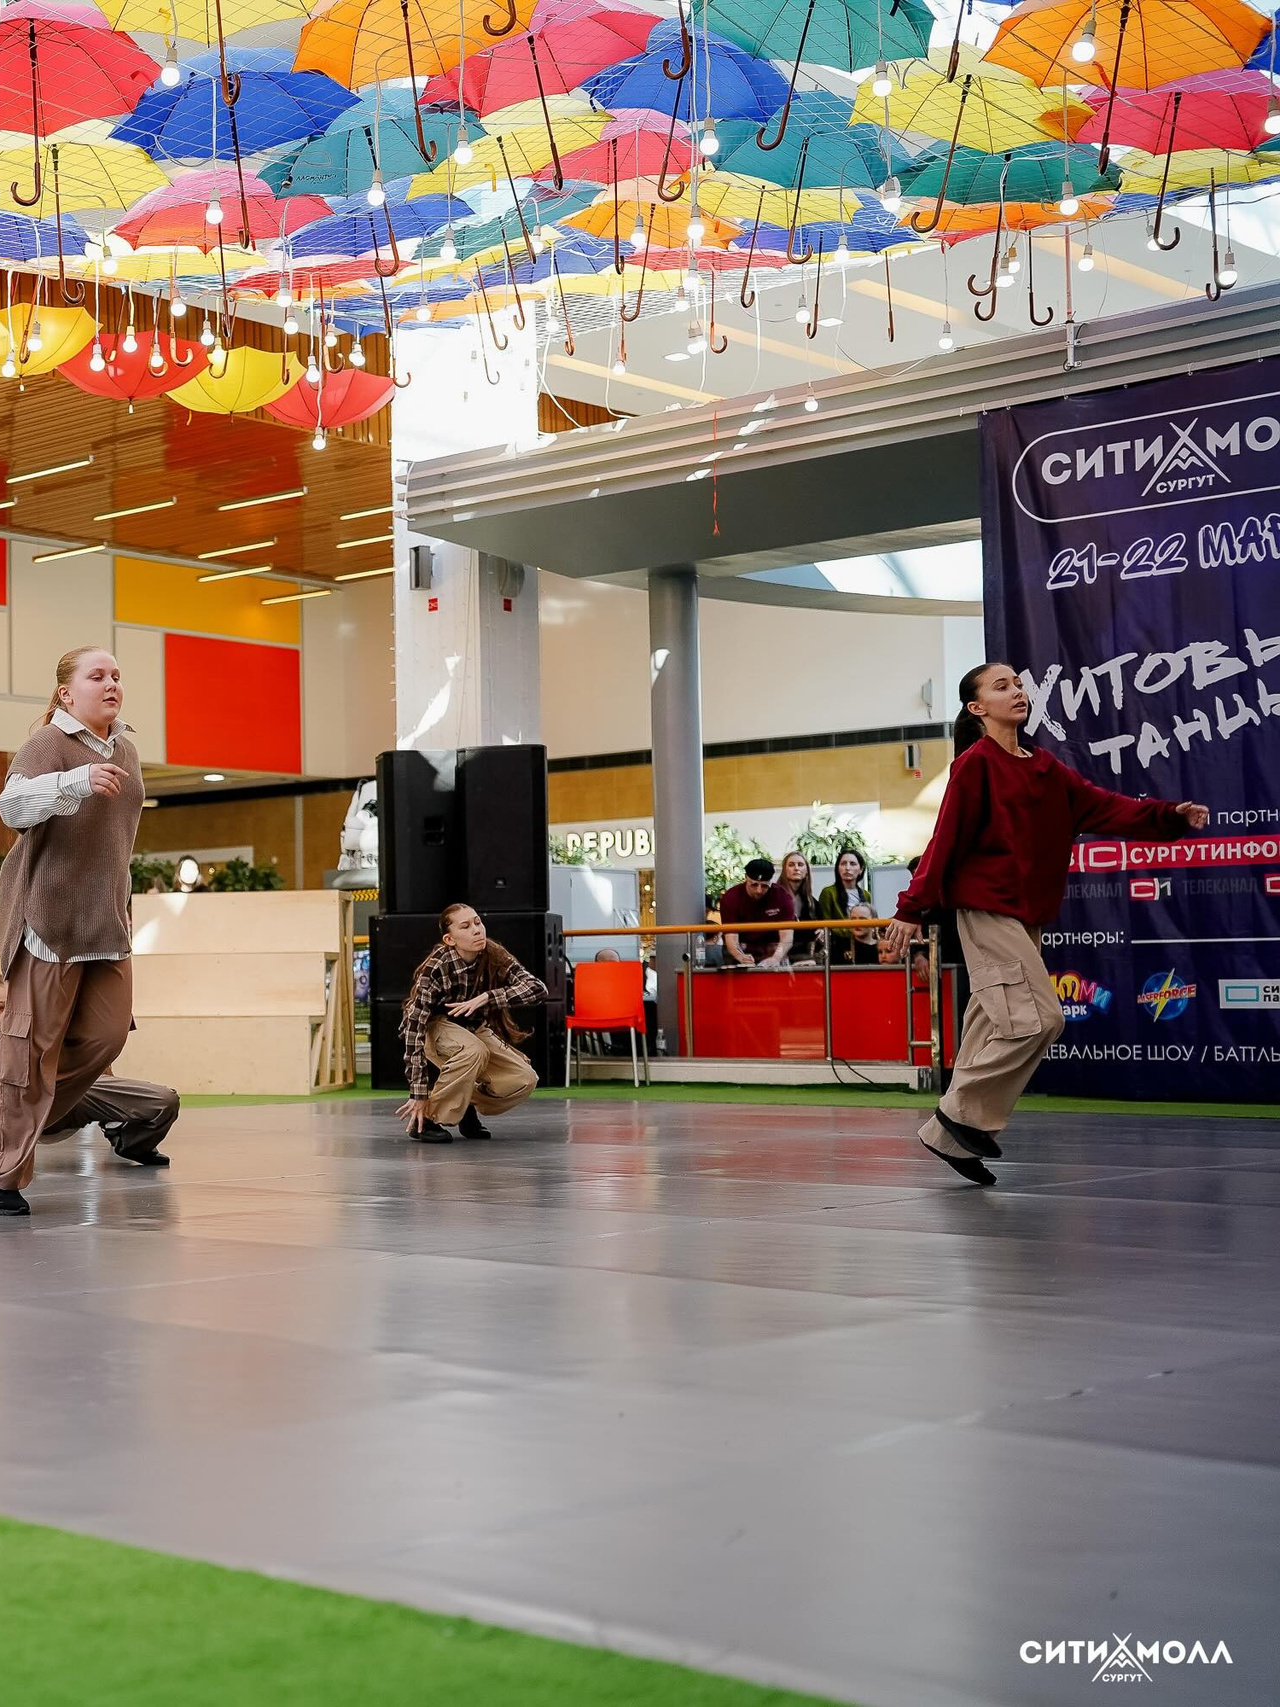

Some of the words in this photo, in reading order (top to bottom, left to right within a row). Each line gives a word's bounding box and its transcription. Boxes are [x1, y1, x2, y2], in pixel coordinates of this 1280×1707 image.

[1041, 435, 1164, 485] СИТИ
[1156, 473, 1216, 494] СУРГУТ
[1046, 532, 1189, 590] 21-22
[566, 828, 655, 860] REPUB
[1129, 840, 1280, 864] СУРГУТИНФО
[1041, 931, 1125, 948] артнеры:
[1061, 1004, 1087, 1018] арк
[1148, 1045, 1194, 1062] ШОУ
